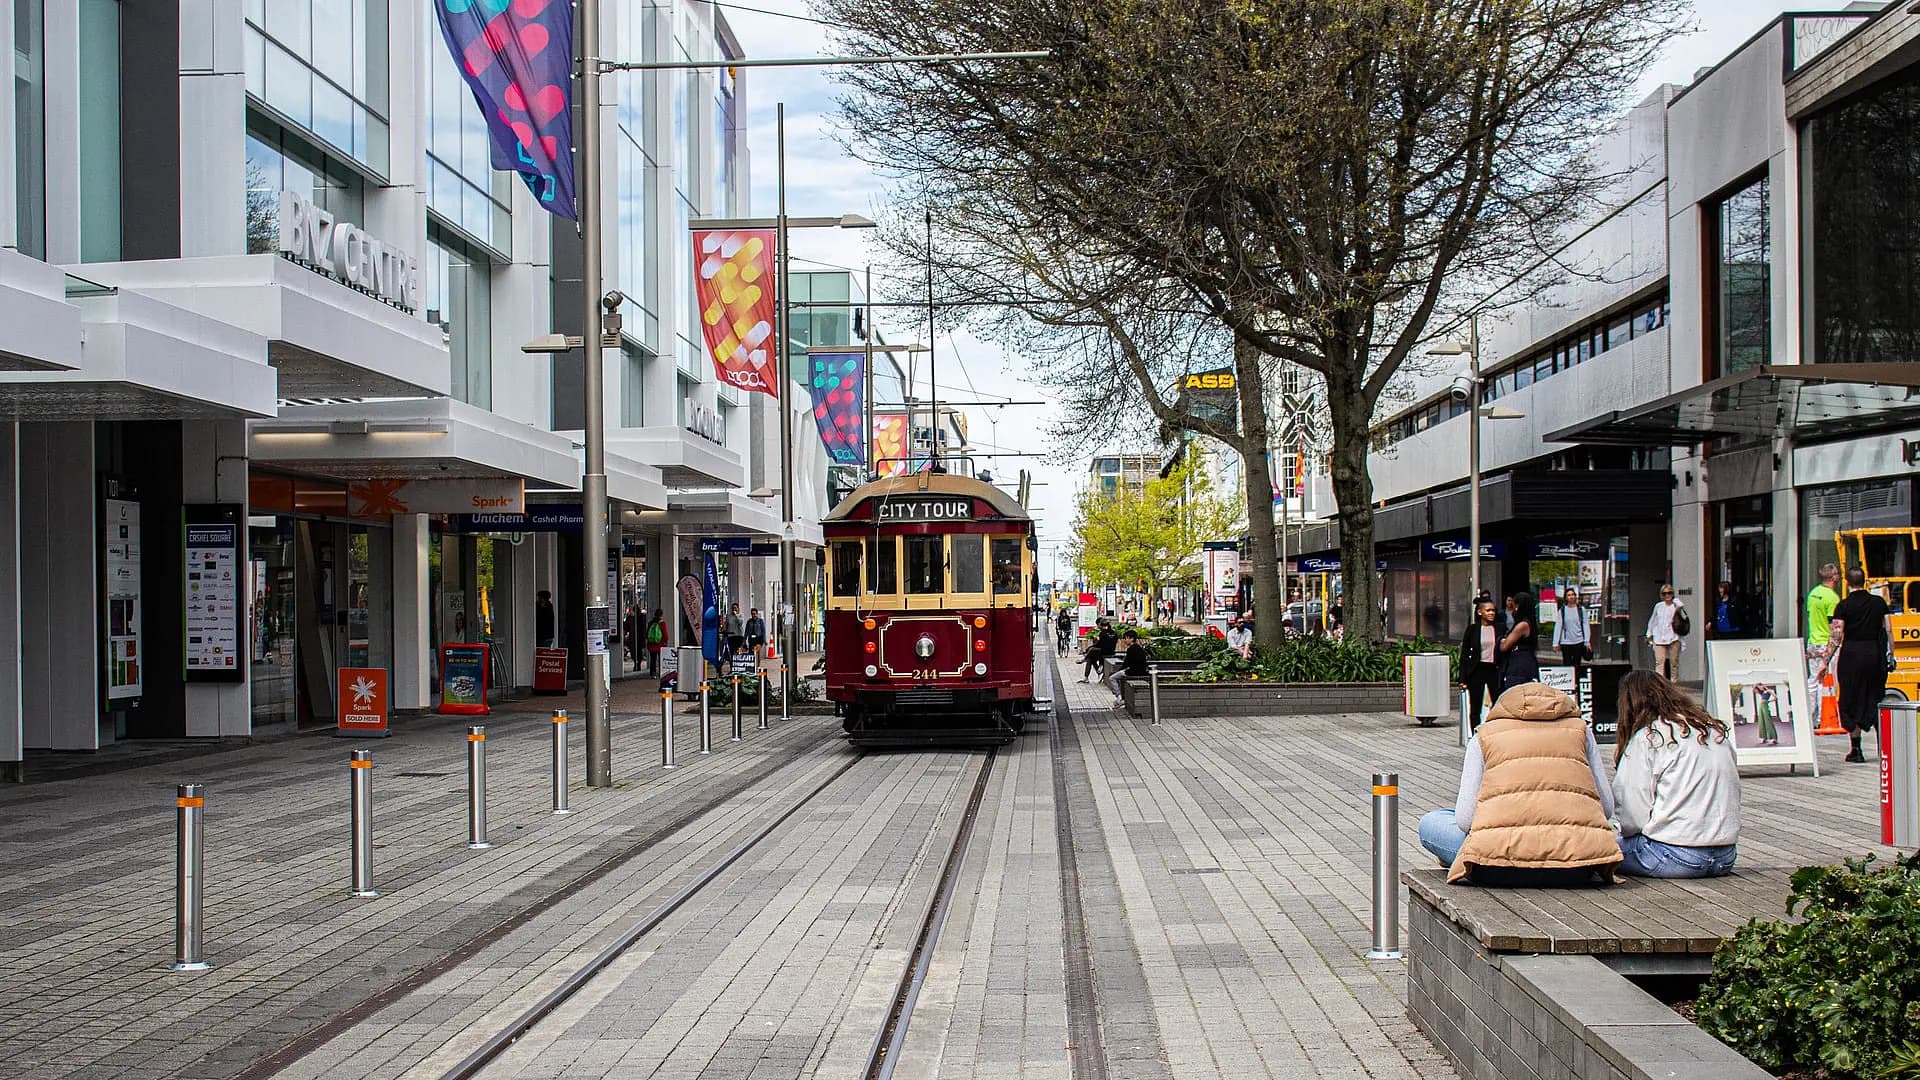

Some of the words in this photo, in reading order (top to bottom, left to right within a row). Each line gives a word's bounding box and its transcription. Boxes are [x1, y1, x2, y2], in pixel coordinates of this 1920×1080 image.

[280, 191, 334, 273] BNZ
[334, 223, 416, 311] CENTRE
[1185, 374, 1235, 389] ASB
[471, 495, 508, 508] Spark
[880, 503, 916, 518] CITY
[921, 502, 968, 518] TOUR
[472, 513, 523, 524] Unichem
[532, 515, 557, 523] Cashel
[702, 542, 718, 551] bnz
[913, 669, 938, 680] 244
[1595, 723, 1618, 732] OPE
[1881, 750, 1889, 804] Litter
